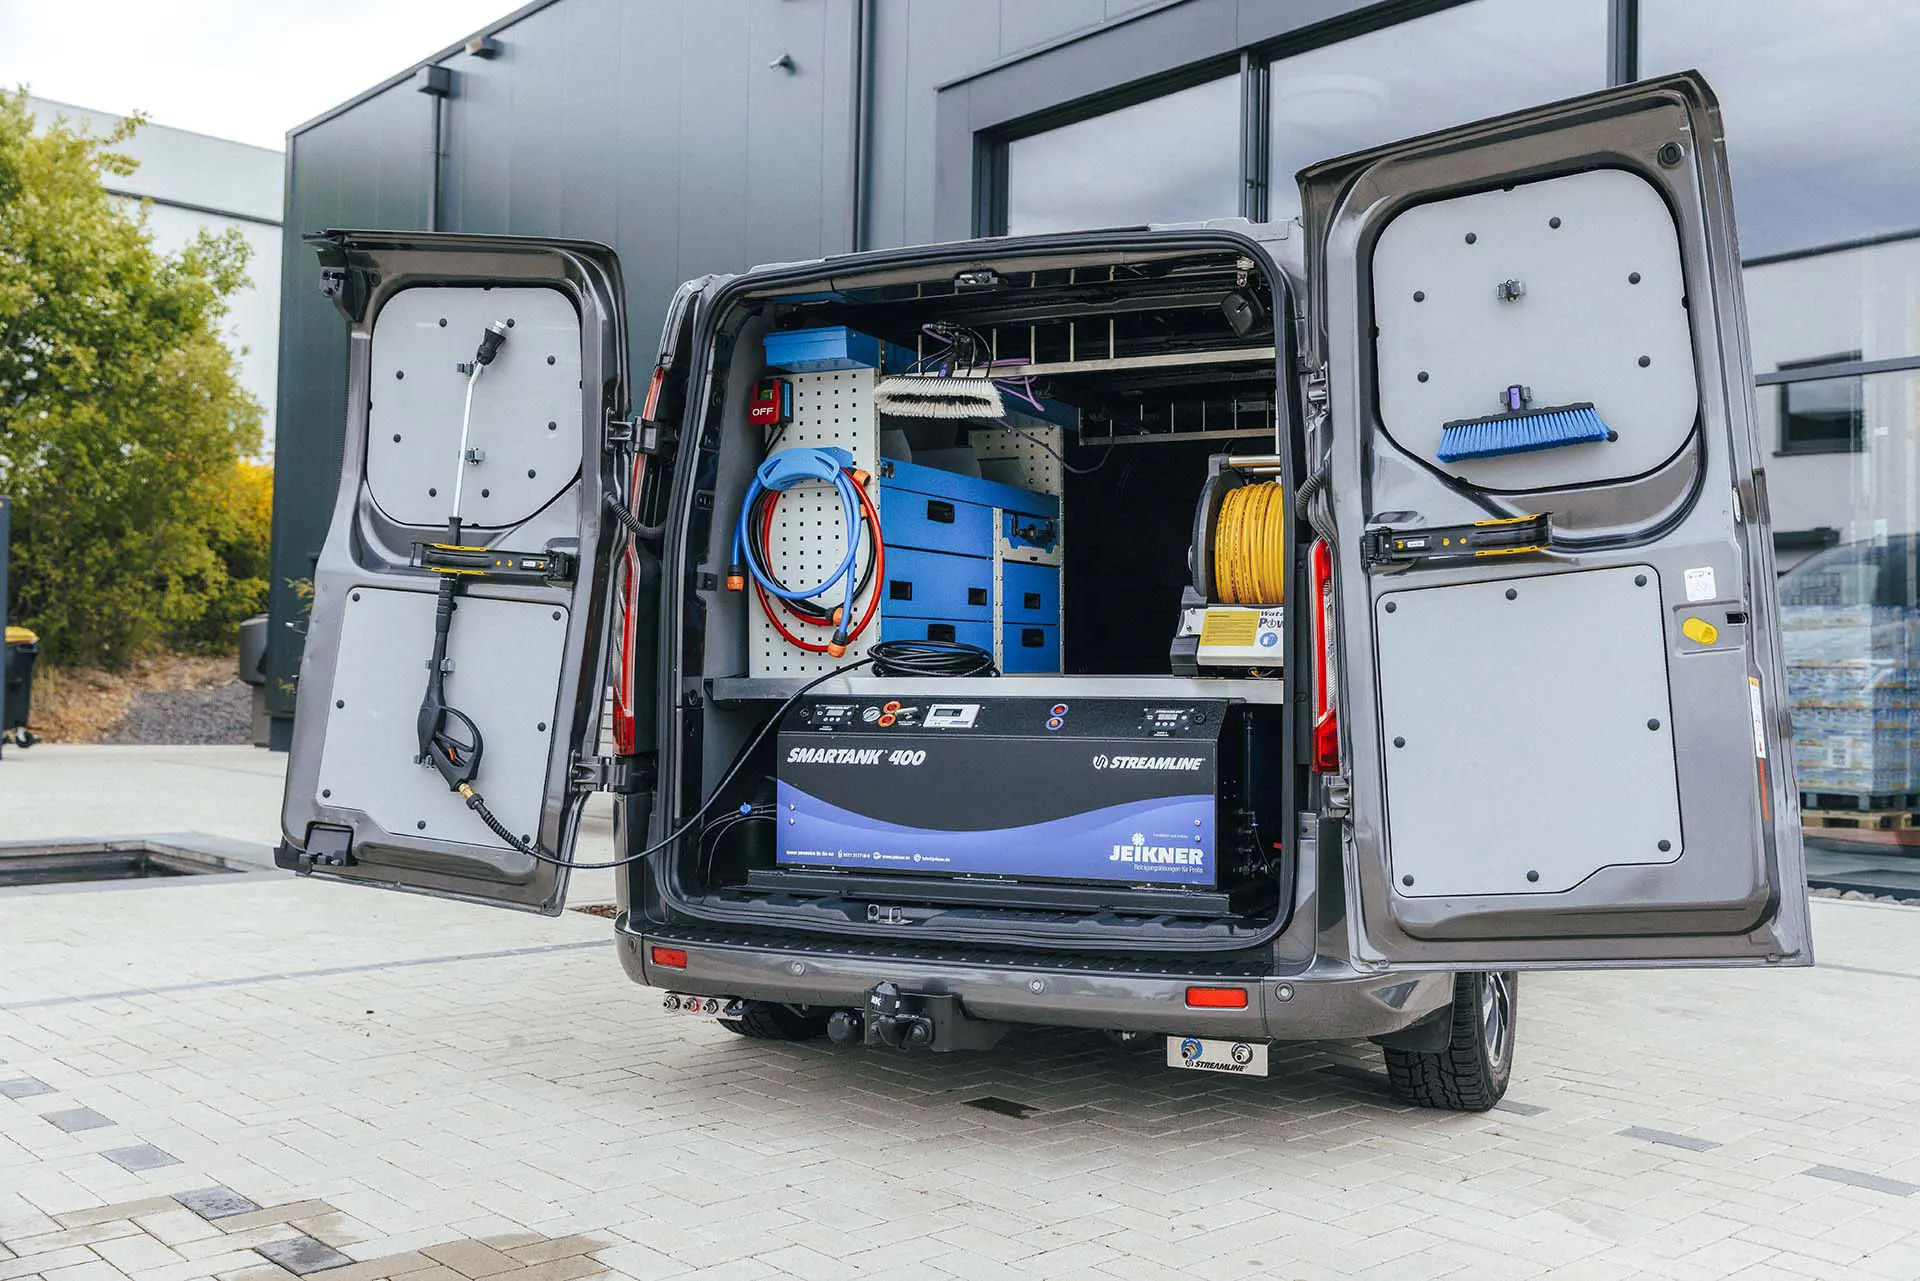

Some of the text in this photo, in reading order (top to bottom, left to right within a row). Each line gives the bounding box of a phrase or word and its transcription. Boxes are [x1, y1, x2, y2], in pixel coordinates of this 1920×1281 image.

[752, 407, 774, 417] OFF
[787, 747, 927, 766] SMARTANK 400
[1109, 756, 1203, 771] STREAMLINE
[1109, 842, 1204, 865] JEIKNER
[1194, 1060, 1246, 1072] STREAMLINE
